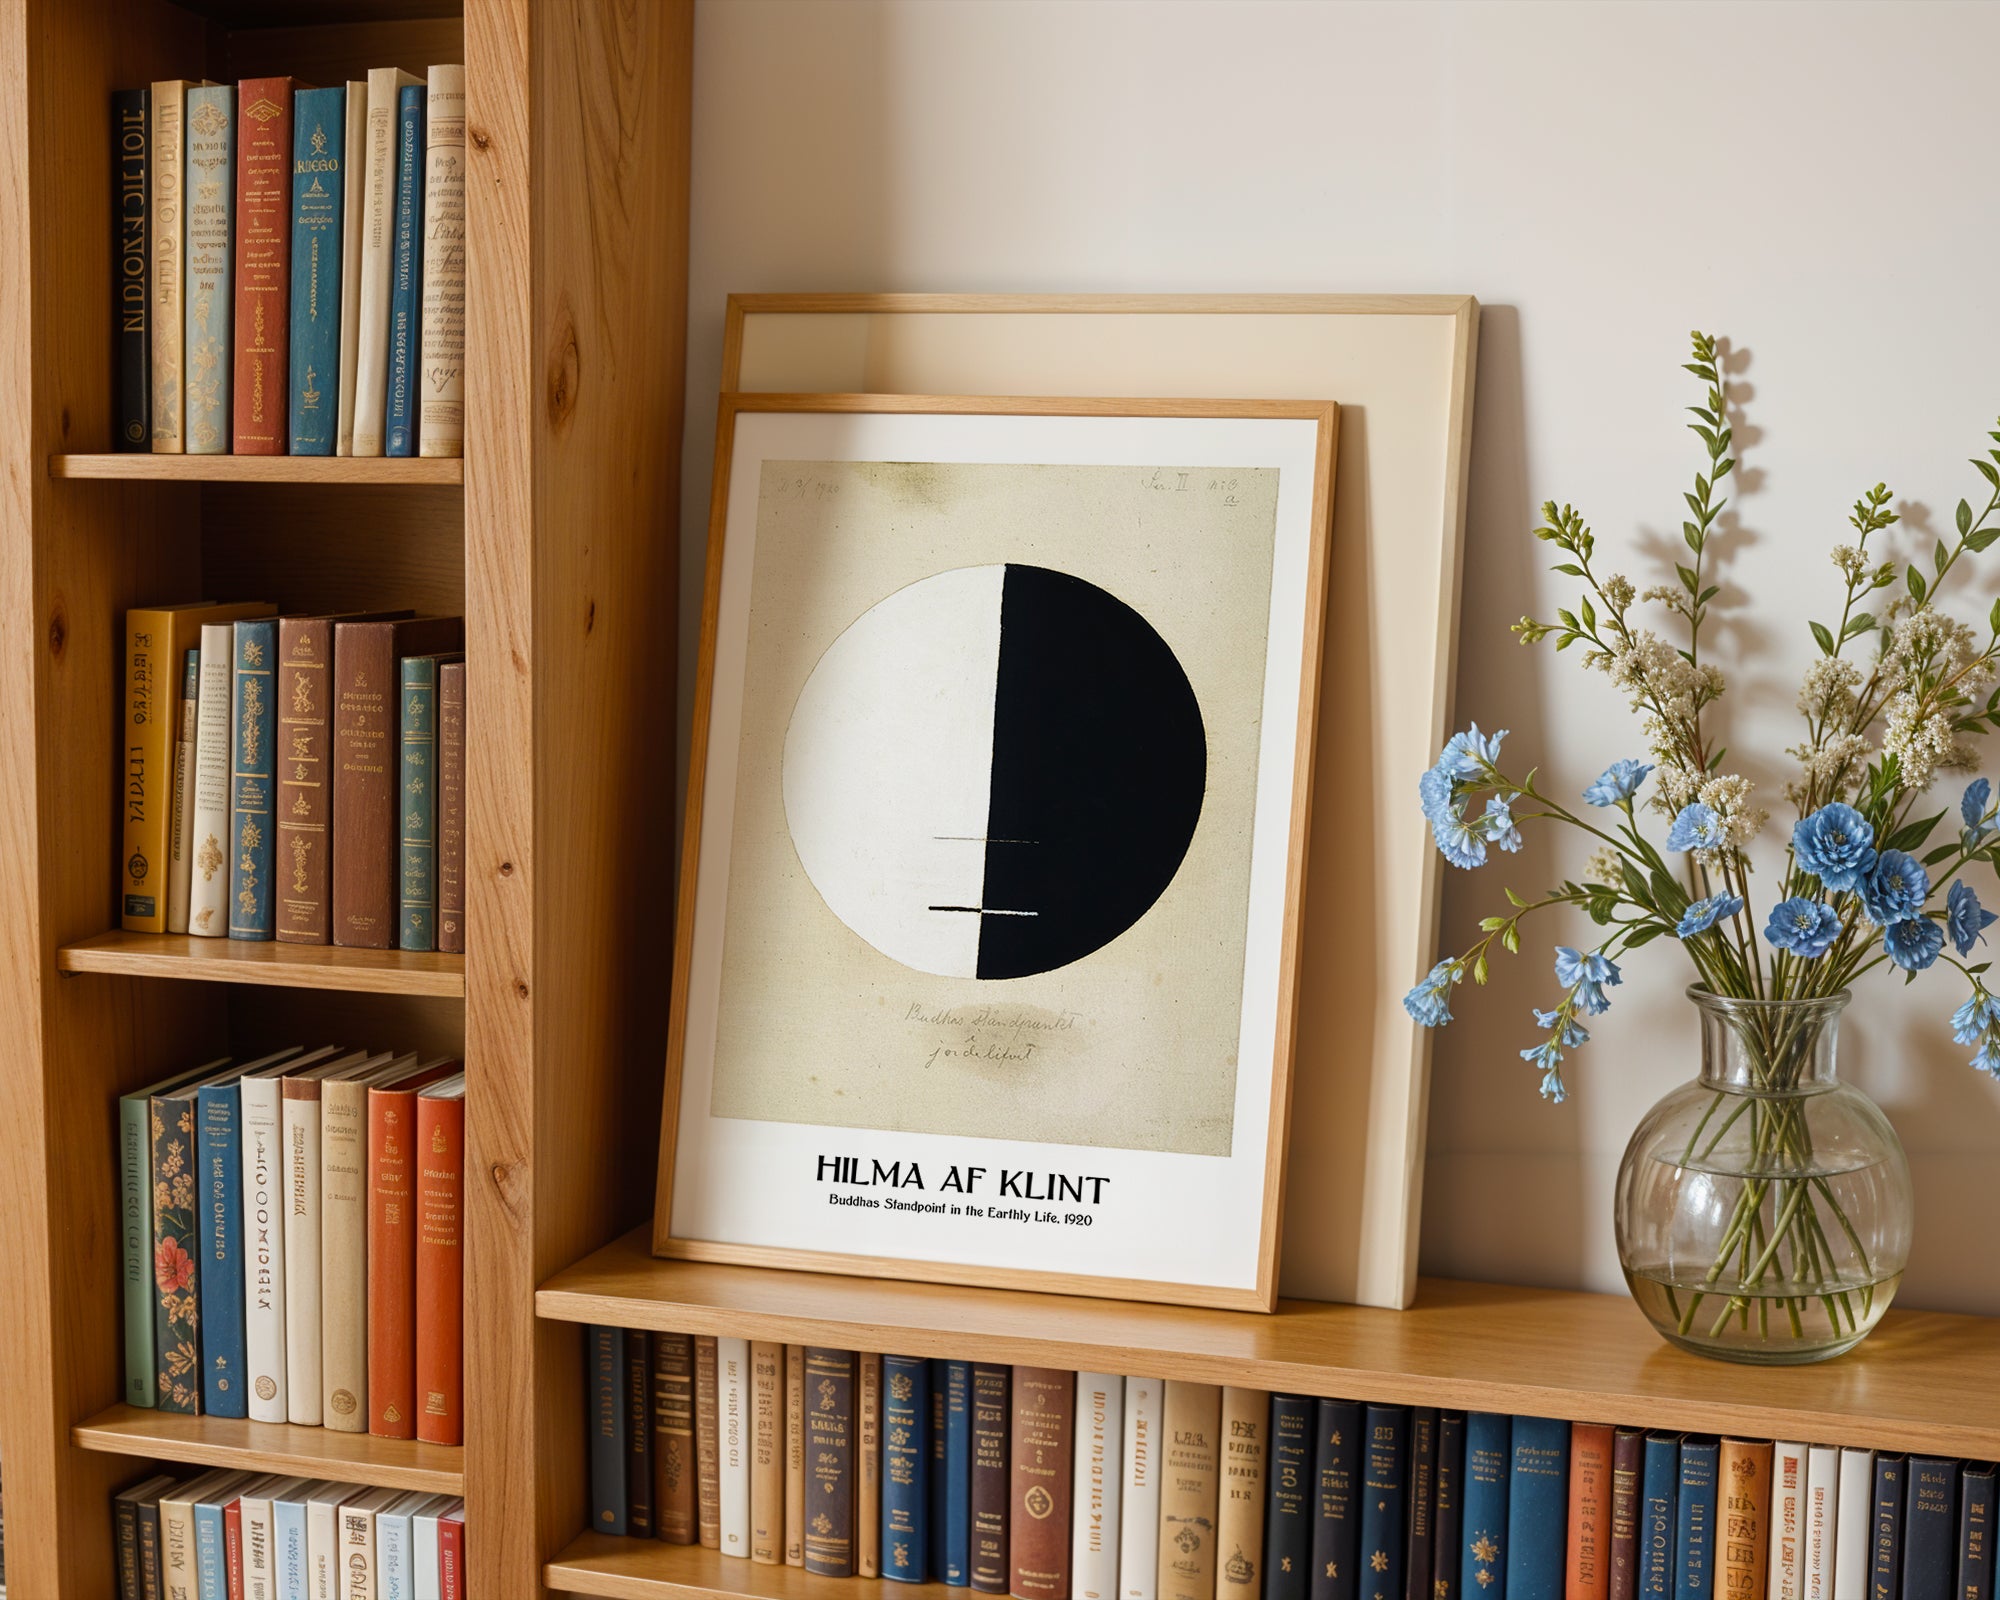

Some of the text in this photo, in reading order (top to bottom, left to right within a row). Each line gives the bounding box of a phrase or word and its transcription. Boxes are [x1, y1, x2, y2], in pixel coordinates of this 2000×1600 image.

[816, 1154, 1111, 1205] HILMA AF KLINT
[829, 1193, 880, 1209] Buddhas
[883, 1197, 946, 1214] Standpoint
[950, 1204, 961, 1215] in
[965, 1205, 983, 1217] the
[987, 1207, 1031, 1223] Earthly
[1064, 1213, 1093, 1227] 1920
